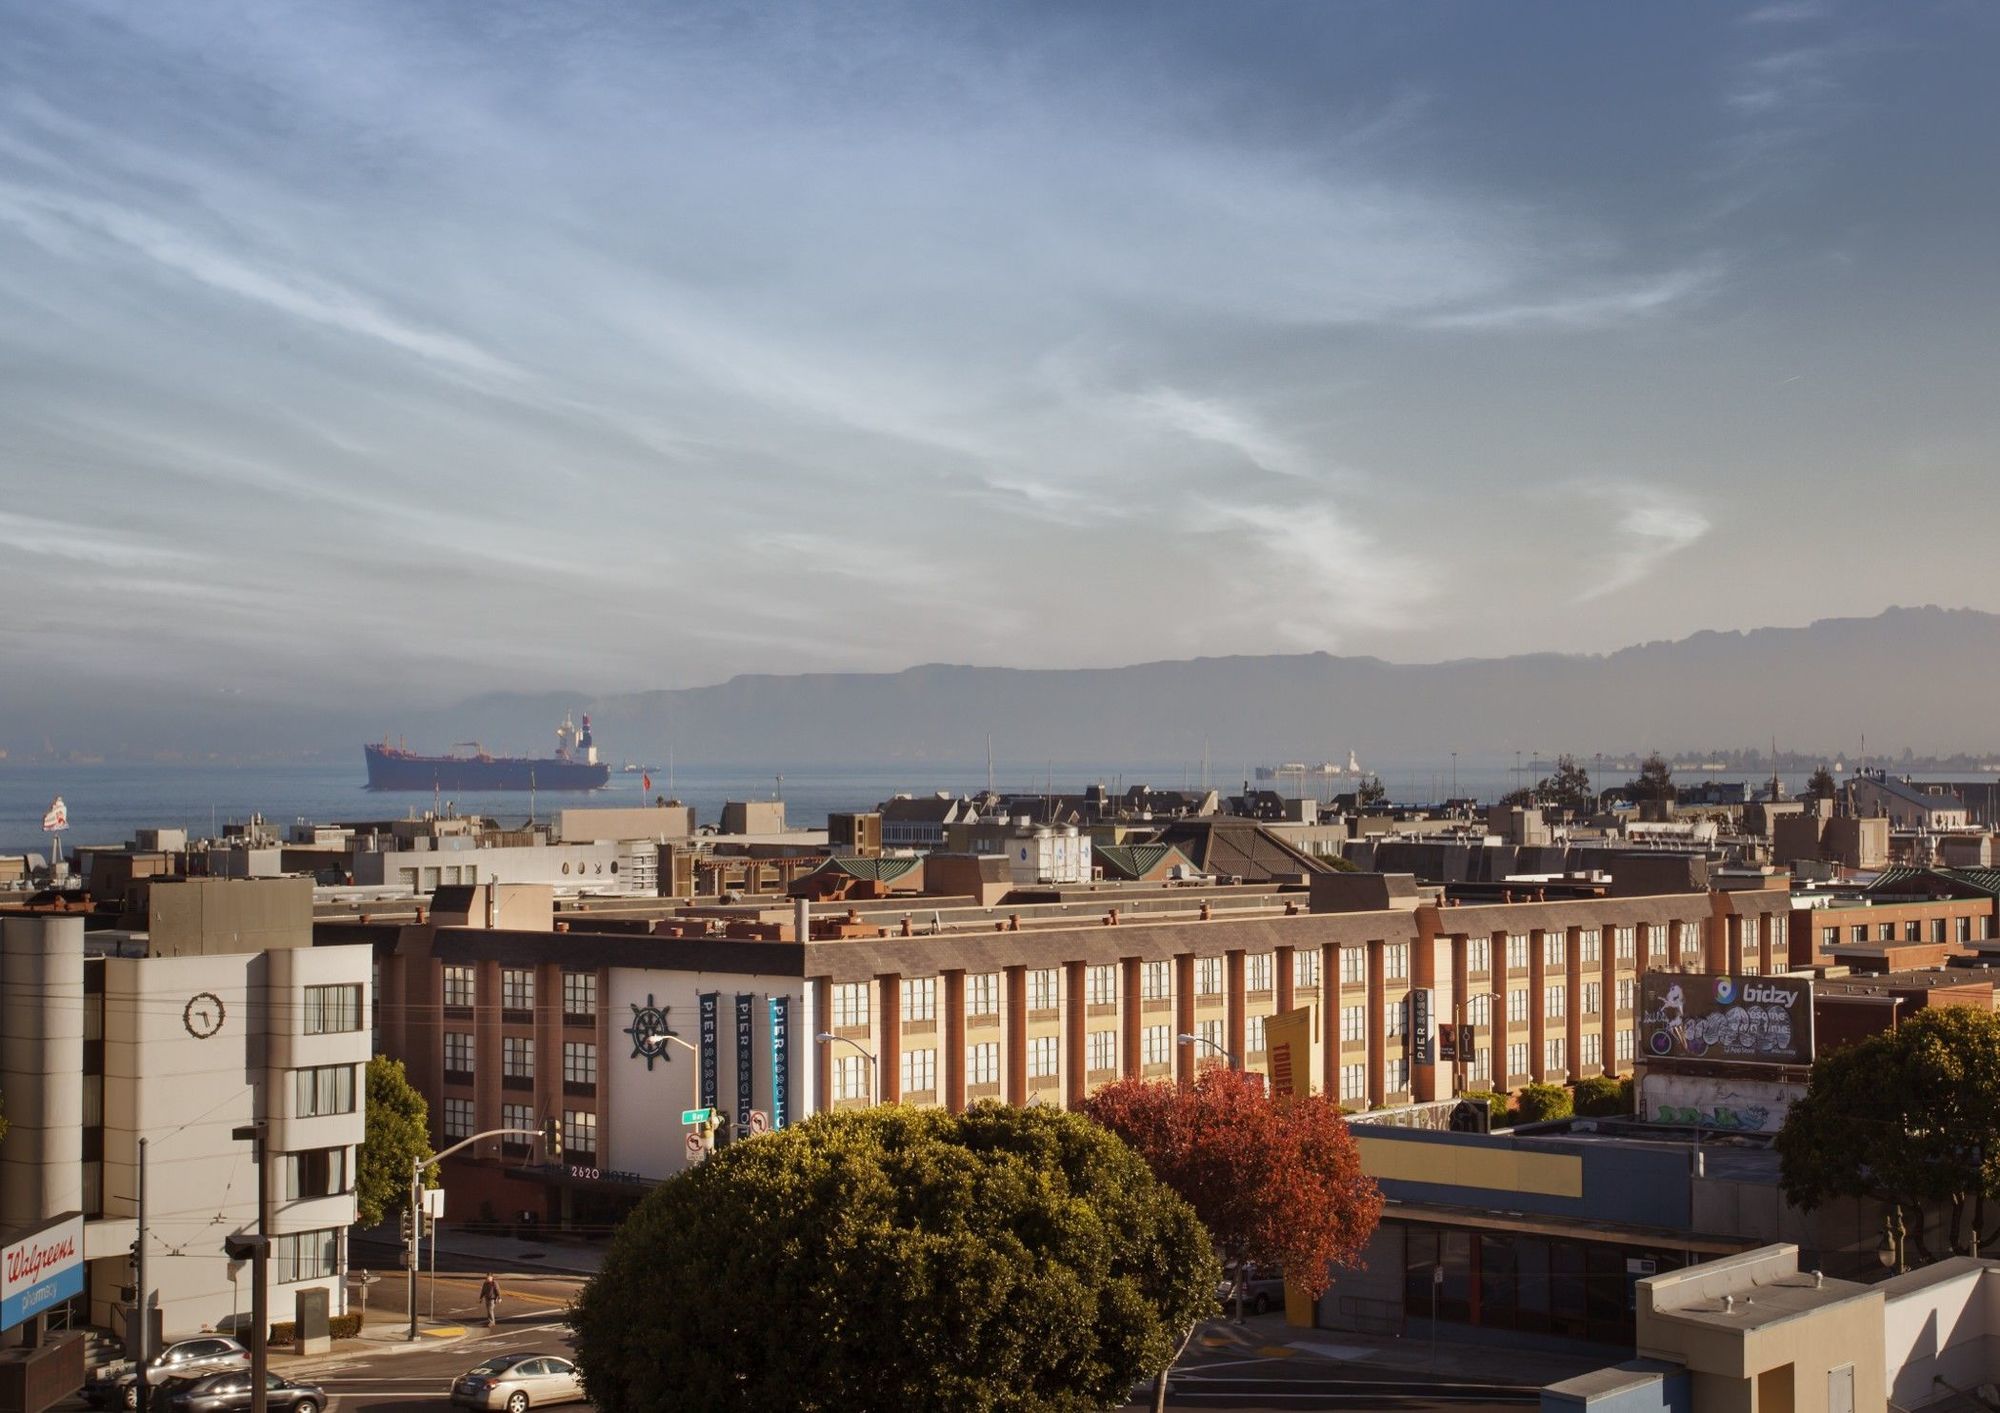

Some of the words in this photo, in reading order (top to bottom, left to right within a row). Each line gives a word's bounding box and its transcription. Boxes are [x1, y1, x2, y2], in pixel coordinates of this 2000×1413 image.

[1743, 984, 1798, 1008] bidzy
[704, 1002, 713, 1043] PIER
[740, 1003, 749, 1045] PIER
[774, 1006, 784, 1049] PIER
[1417, 1028, 1425, 1059] PIER
[571, 1166, 600, 1179] 2620
[7, 1235, 75, 1283] Walgreens
